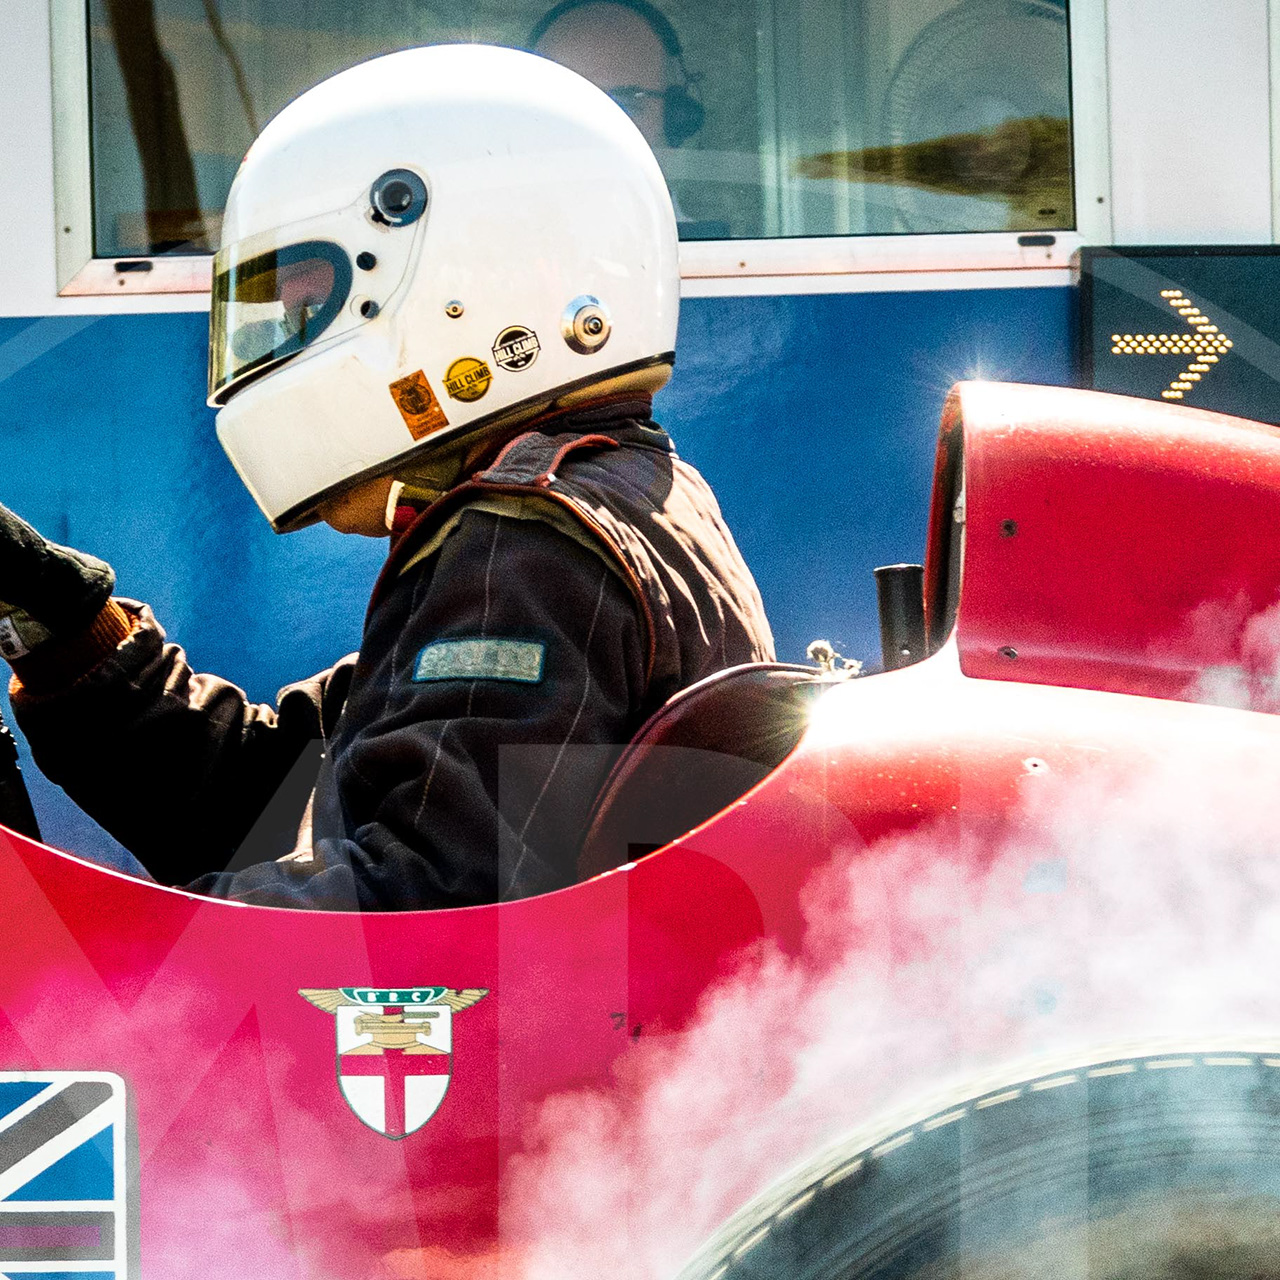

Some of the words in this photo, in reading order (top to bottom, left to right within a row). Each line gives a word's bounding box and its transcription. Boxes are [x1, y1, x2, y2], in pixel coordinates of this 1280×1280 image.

[494, 346, 514, 362] HILL
[512, 336, 539, 355] CLIMB
[446, 378, 465, 393] HILL
[464, 366, 491, 384] CLIMB
